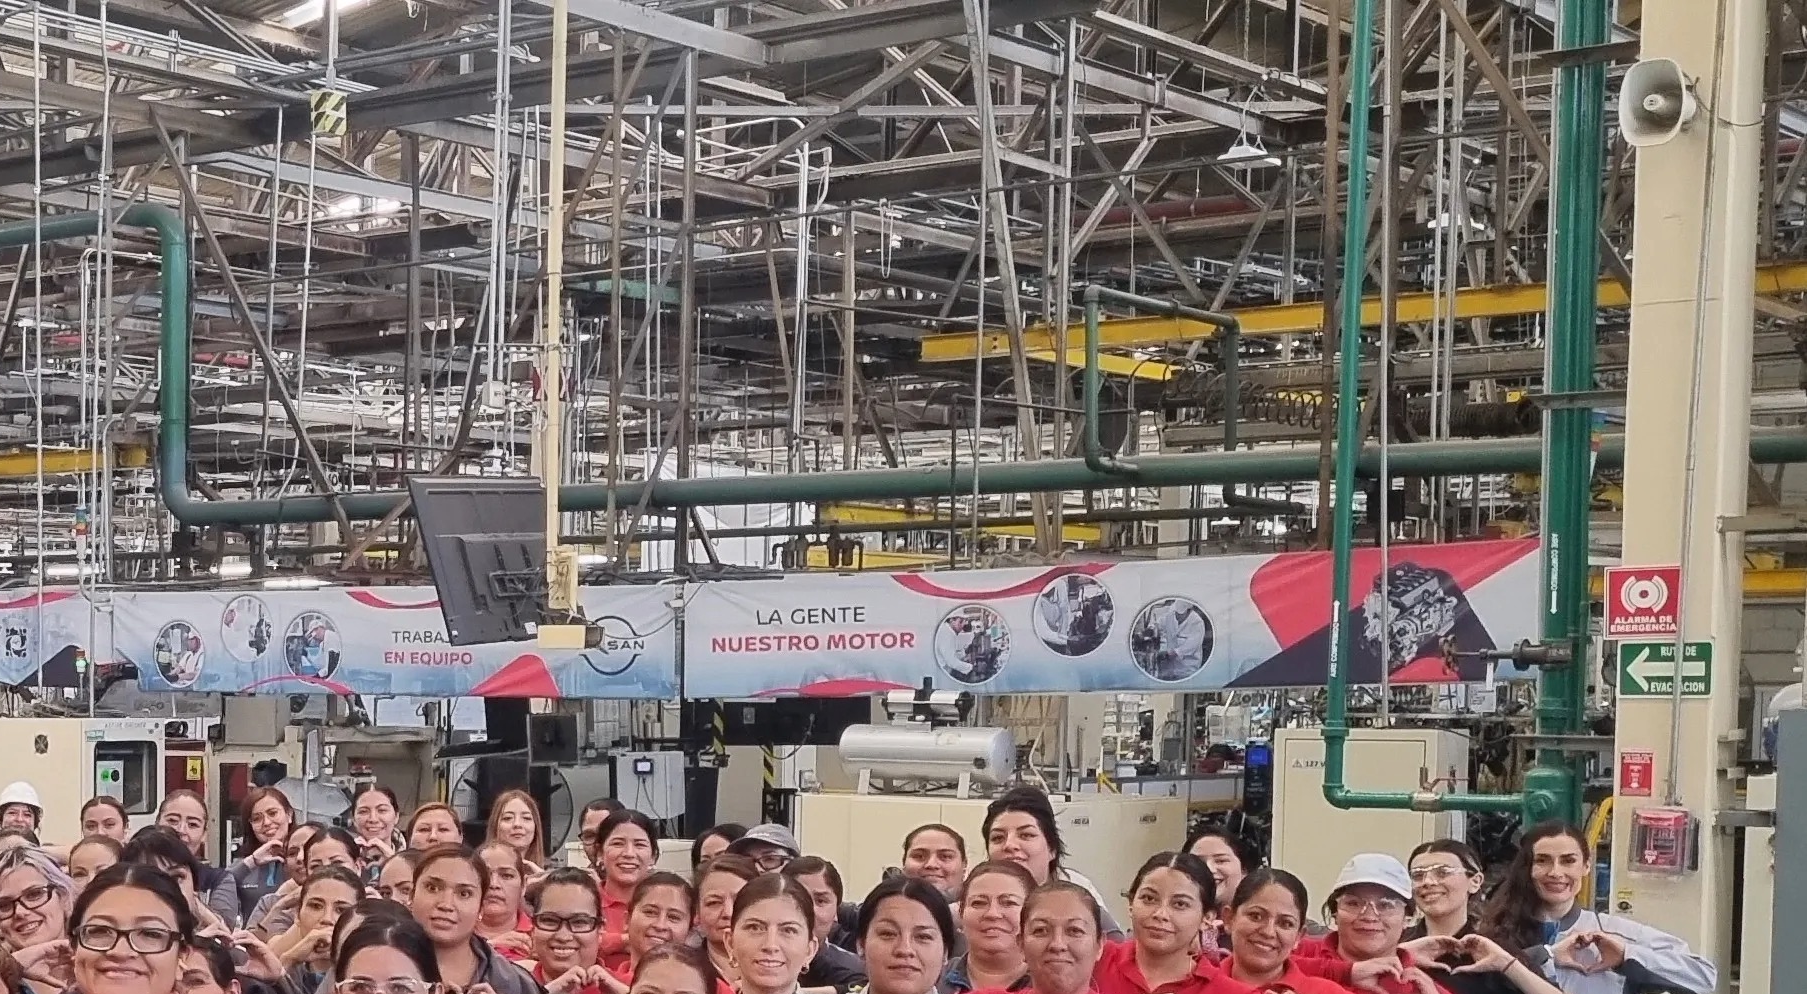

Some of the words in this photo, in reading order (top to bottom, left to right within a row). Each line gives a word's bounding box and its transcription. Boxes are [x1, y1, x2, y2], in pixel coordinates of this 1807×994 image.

[756, 609, 783, 625] LA
[790, 606, 866, 624] GENTE
[1614, 615, 1657, 624] ALARMA
[1659, 615, 1673, 623] DE
[1610, 623, 1677, 633] EMERGENCIA
[712, 634, 820, 653] NUESTRO
[826, 632, 915, 651] MOTOR
[1685, 646, 1697, 657] DE
[384, 651, 408, 665] EN
[410, 652, 474, 666] EQUIPO
